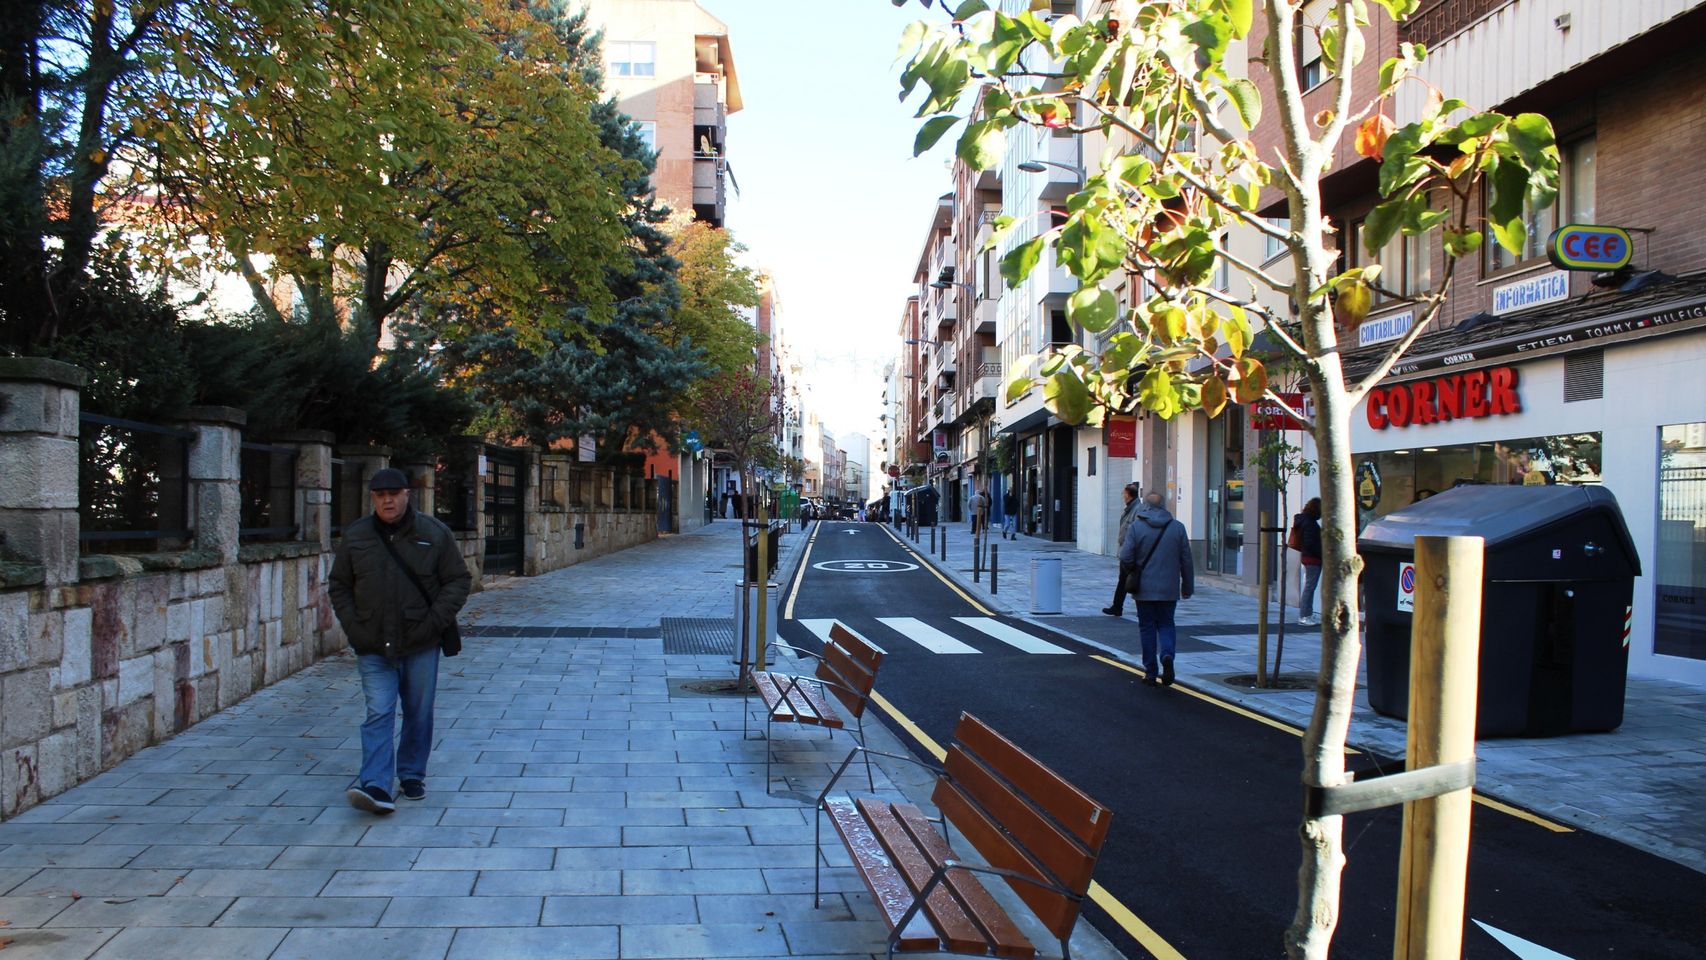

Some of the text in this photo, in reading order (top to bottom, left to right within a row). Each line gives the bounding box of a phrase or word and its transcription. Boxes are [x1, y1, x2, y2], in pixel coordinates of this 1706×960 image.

[1496, 274, 1566, 311] INFORMATICA
[1361, 315, 1411, 343] CONTABILIDAD
[1586, 305, 1706, 338] TOMMY HILFIG
[1517, 334, 1573, 352] ETIEM
[1443, 352, 1475, 365] CORNER
[1367, 366, 1521, 430] CORNER
